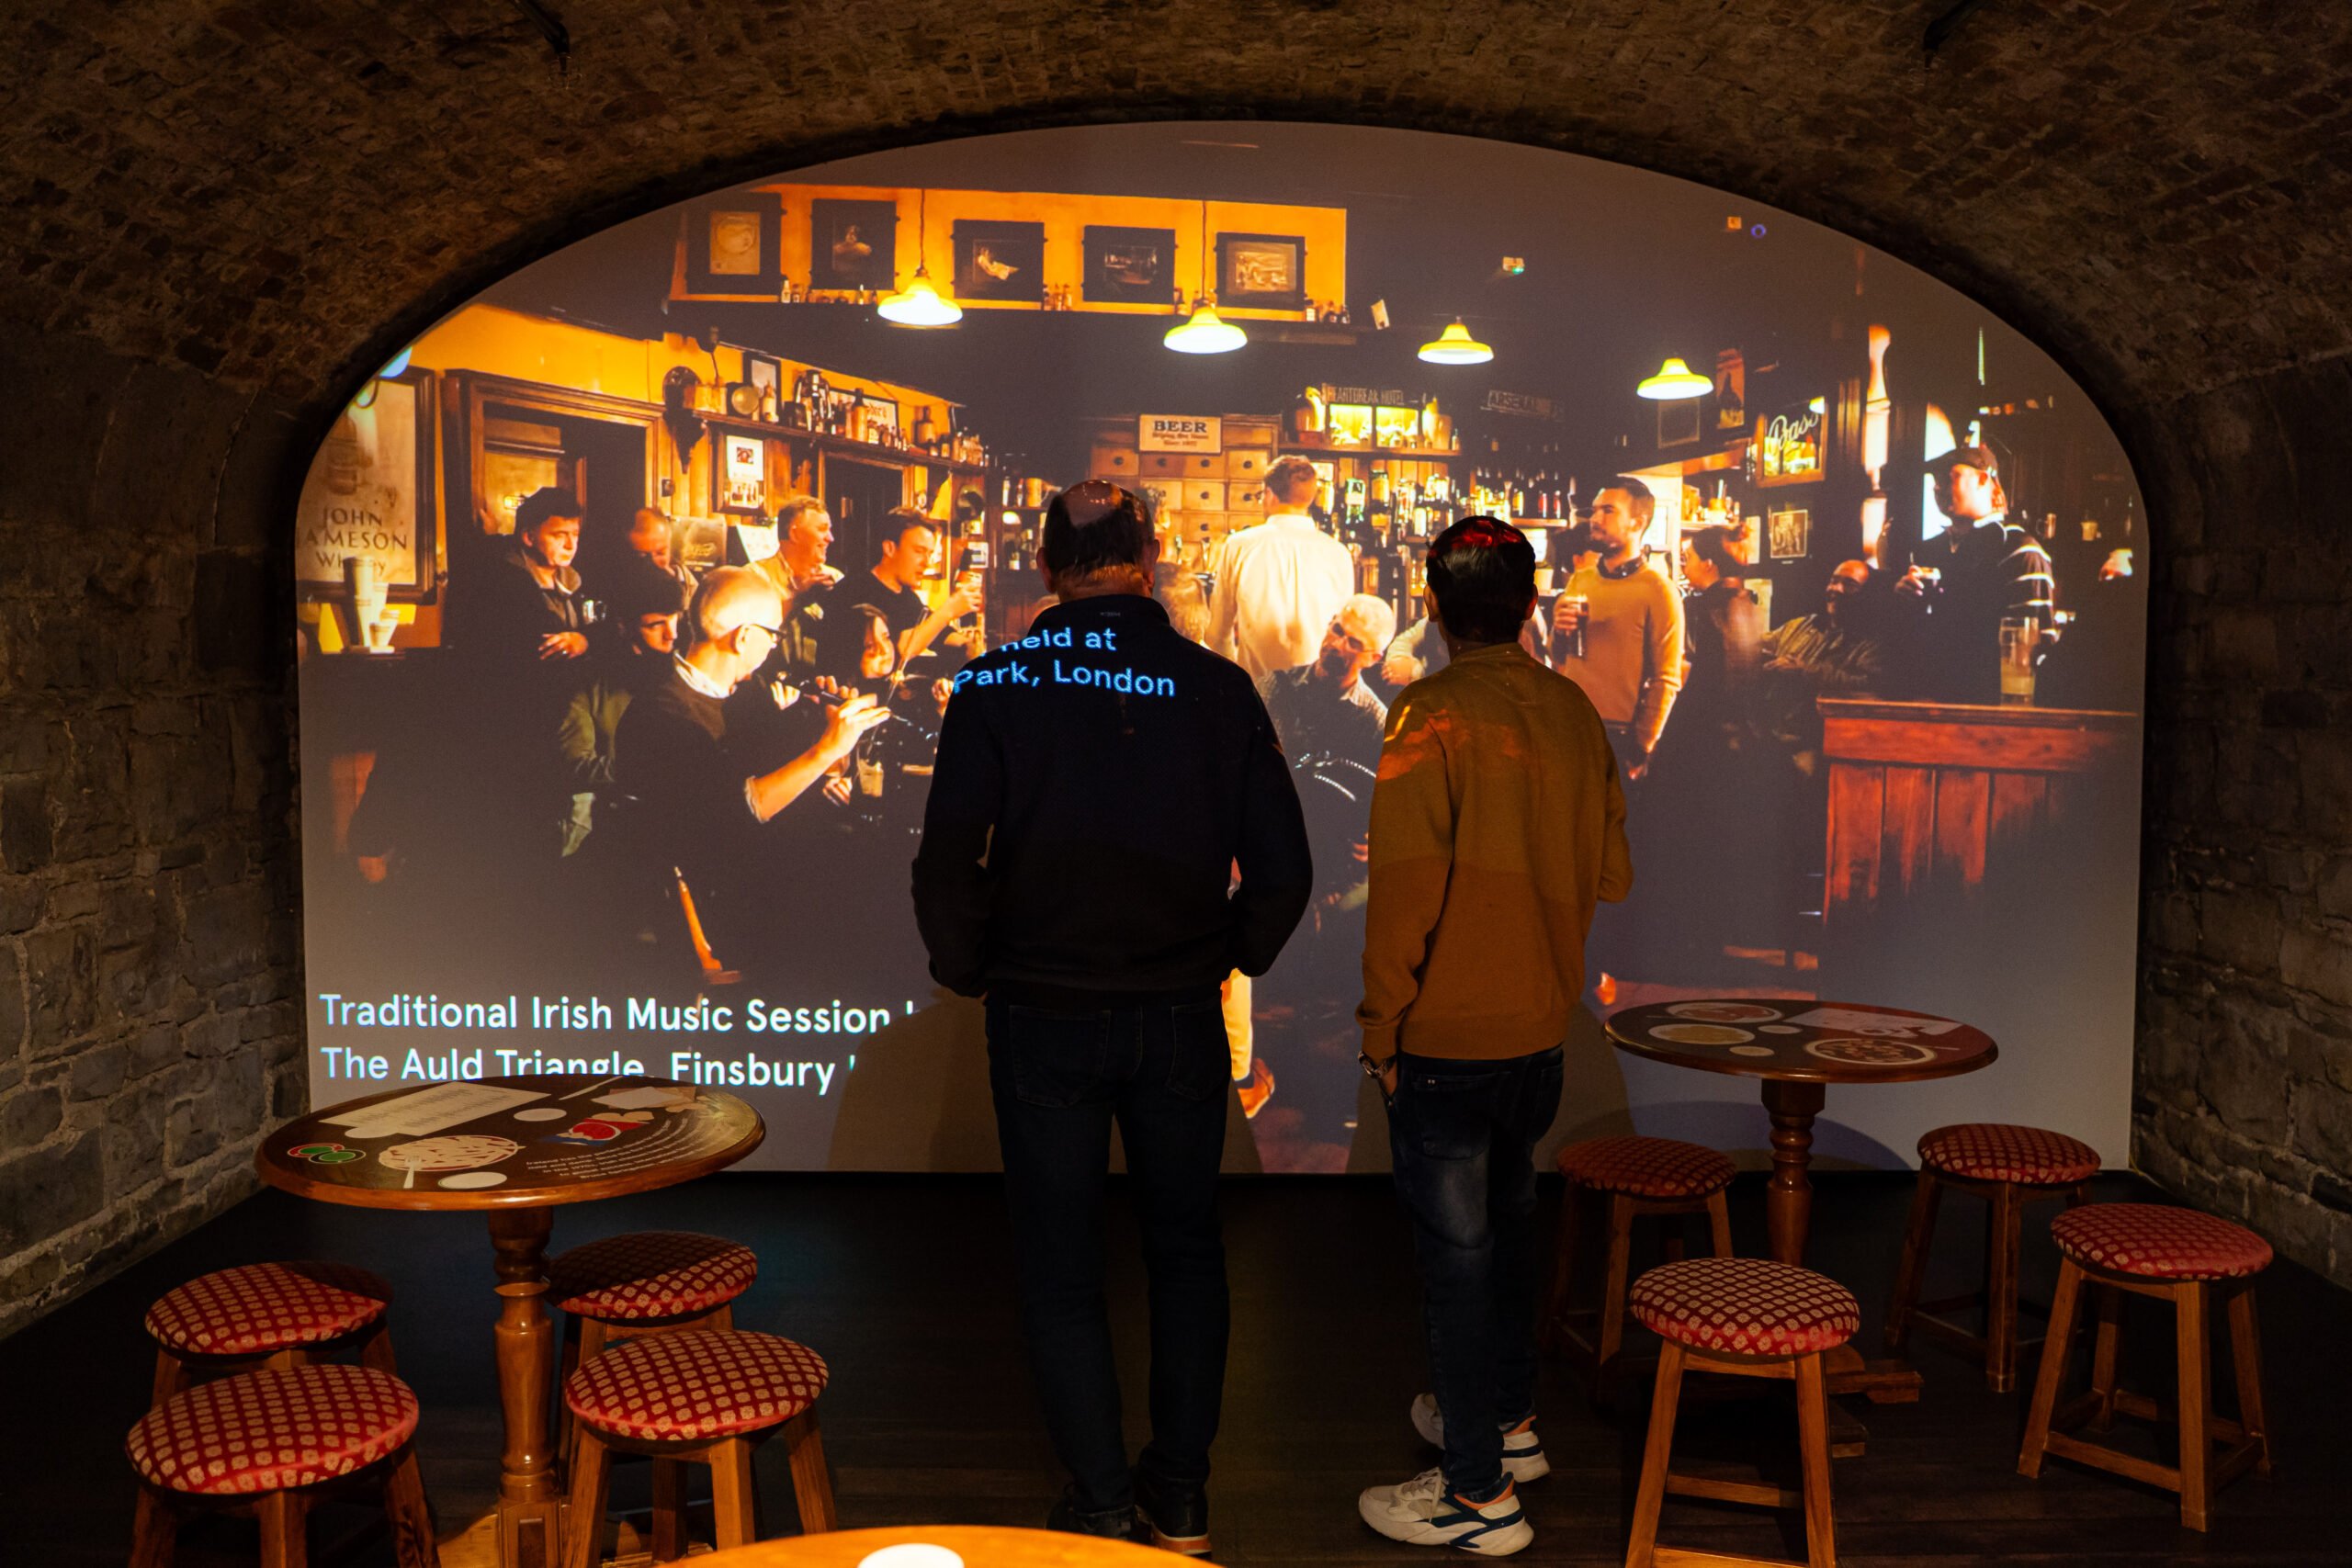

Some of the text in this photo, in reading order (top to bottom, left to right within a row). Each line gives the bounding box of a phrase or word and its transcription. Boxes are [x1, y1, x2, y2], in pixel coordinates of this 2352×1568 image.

[1154, 421, 1208, 433] BEER
[322, 506, 382, 527] JOHN
[1085, 627, 1117, 652] at
[953, 659, 1175, 697] Park, London
[319, 993, 517, 1029] Traditional
[532, 996, 613, 1030] Irish
[628, 998, 734, 1032] Music
[746, 998, 891, 1034] Session
[321, 1047, 390, 1079] The
[401, 1048, 483, 1081] Auld
[671, 1052, 836, 1096] Finsbury
